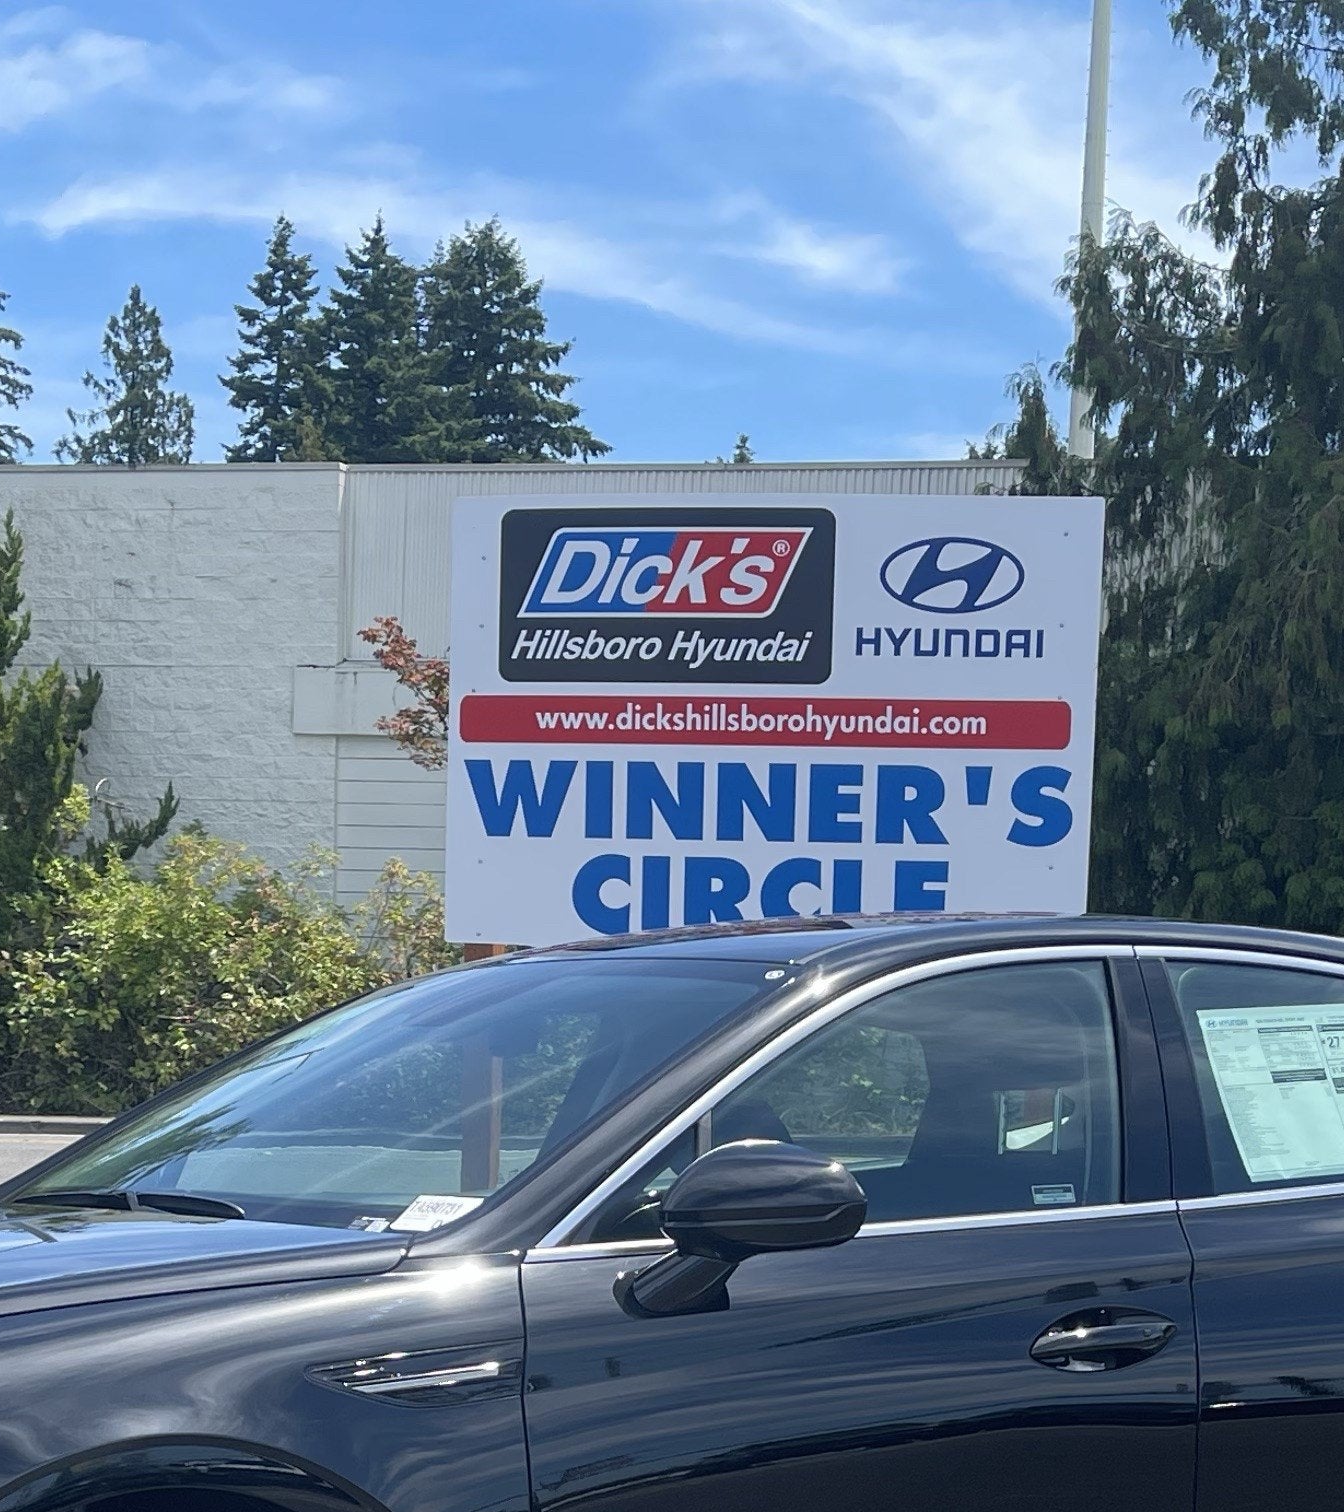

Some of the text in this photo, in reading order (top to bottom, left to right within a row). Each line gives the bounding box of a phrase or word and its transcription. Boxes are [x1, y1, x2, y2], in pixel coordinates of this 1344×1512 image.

[510, 629, 813, 669] Hillsboro Hyundai
[856, 626, 1044, 659] HYUNDAI
[536, 703, 987, 740] www.dickshillsborohyundai.com
[463, 759, 1074, 847] WINNER'S
